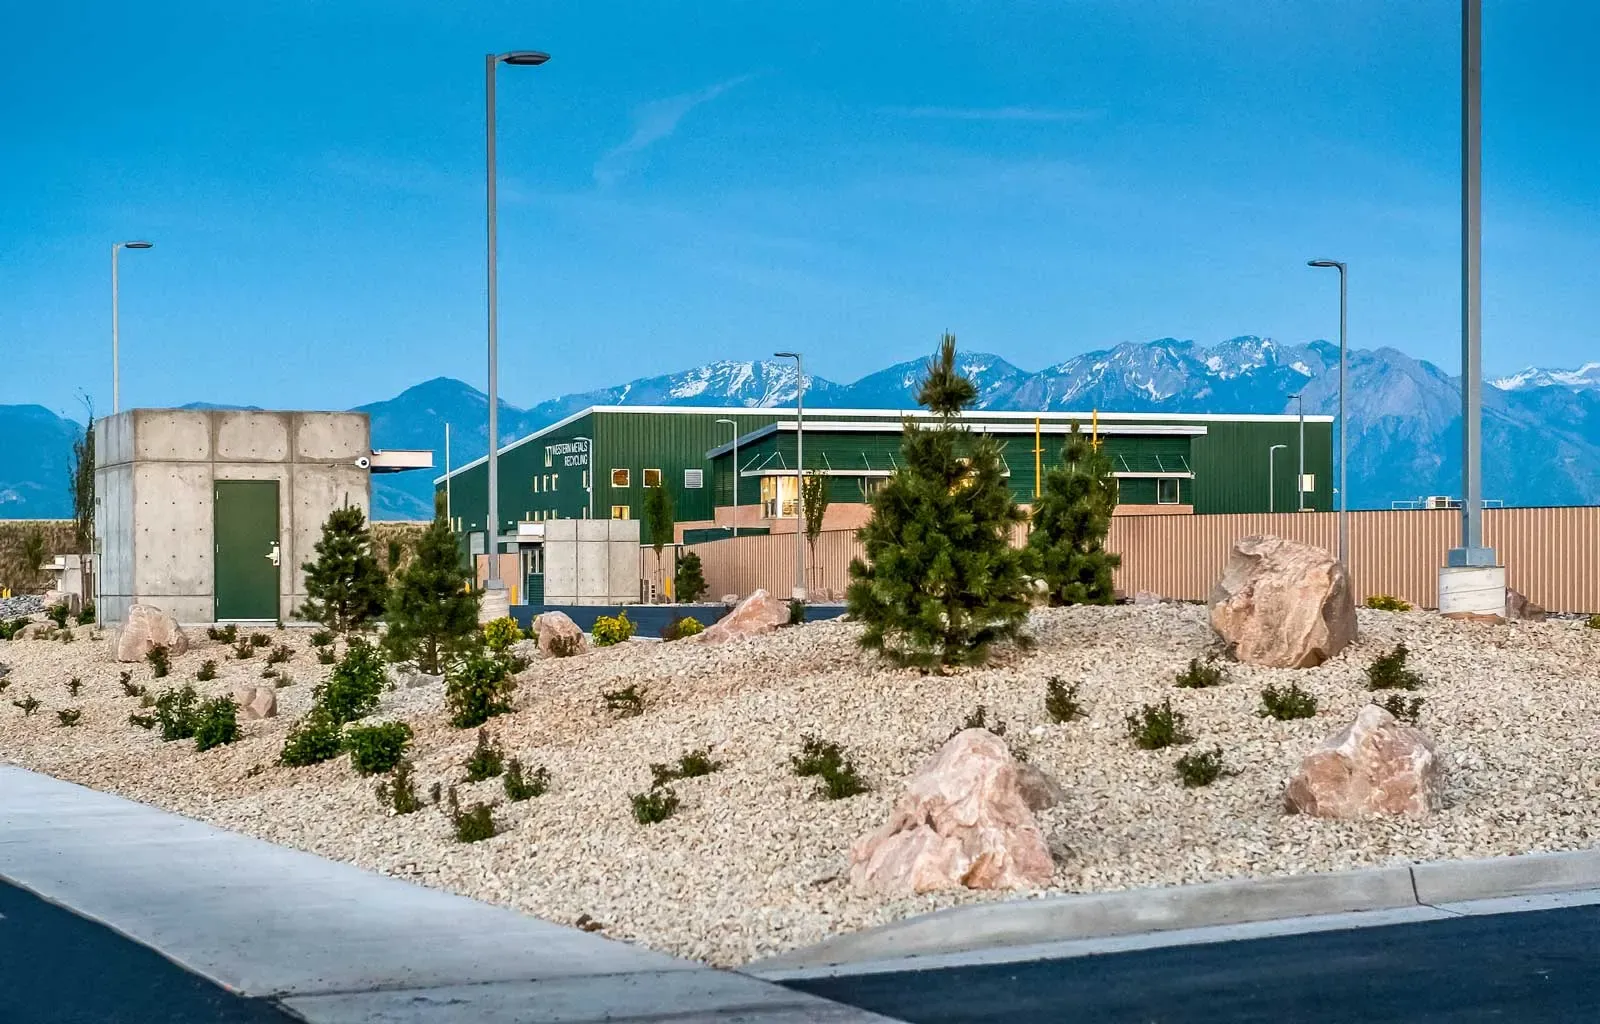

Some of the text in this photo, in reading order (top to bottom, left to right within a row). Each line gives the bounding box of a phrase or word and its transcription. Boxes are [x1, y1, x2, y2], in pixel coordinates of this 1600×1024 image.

[552, 441, 588, 455] WESTERN METALS
[564, 454, 588, 466] RECYCLING
